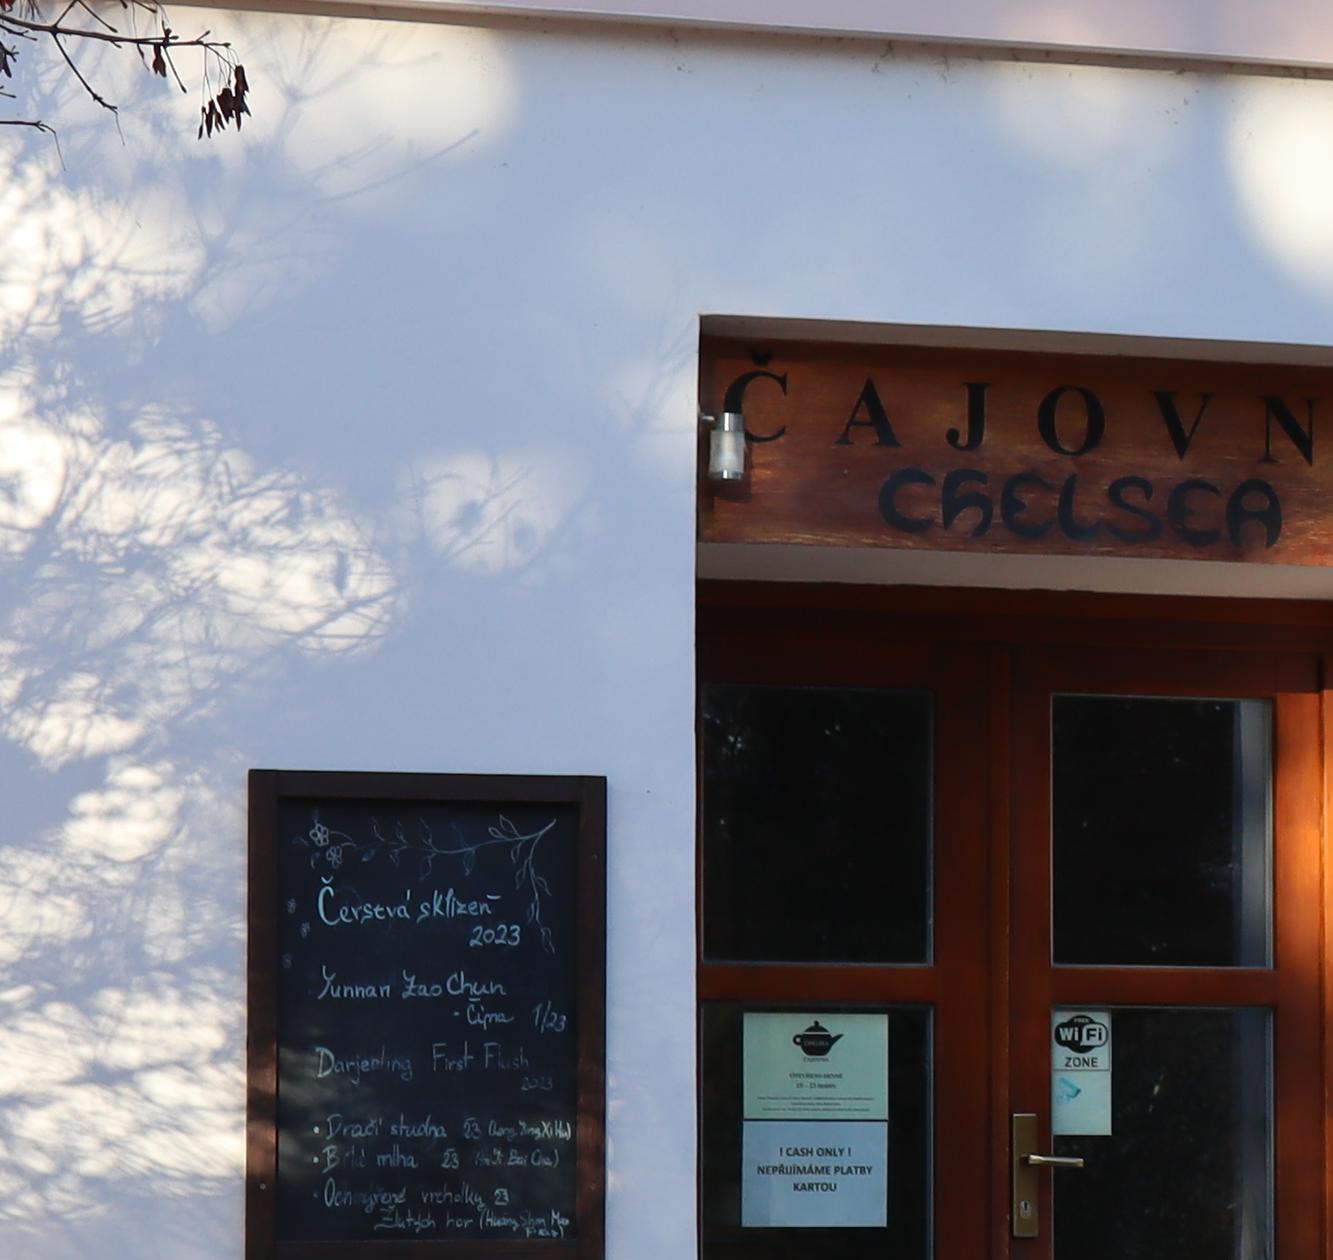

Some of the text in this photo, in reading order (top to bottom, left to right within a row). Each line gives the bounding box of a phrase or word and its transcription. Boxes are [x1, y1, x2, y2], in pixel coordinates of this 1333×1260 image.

[317, 875, 412, 926] Čerstvá
[469, 924, 521, 948] 2023
[317, 964, 392, 1000] Yunnan
[531, 1000, 567, 1033] 1/23
[315, 1043, 413, 1087] Darjeeling
[432, 1040, 475, 1072] First
[1065, 1056, 1099, 1068] ZONE
[786, 1146, 813, 1158] CASH
[816, 1146, 845, 1158] ONLY
[833, 1165, 873, 1177] PLATBY
[792, 1182, 838, 1193] KARTOU
